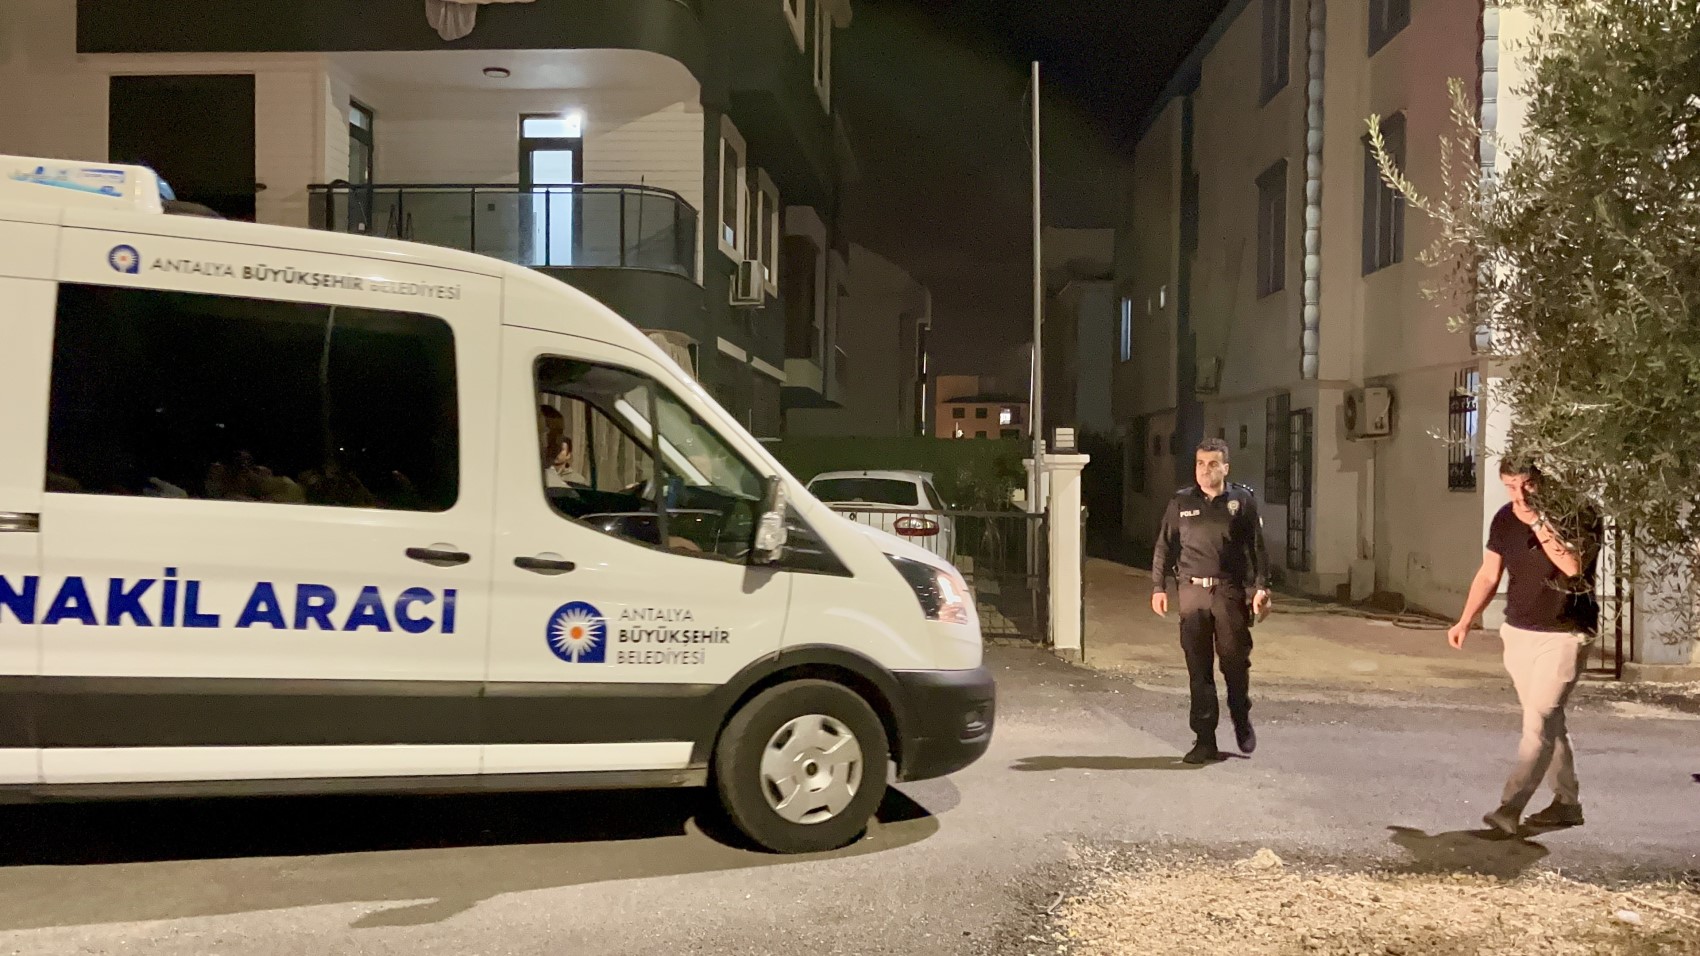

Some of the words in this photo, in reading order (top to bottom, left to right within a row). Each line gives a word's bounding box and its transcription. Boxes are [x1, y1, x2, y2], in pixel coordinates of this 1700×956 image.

[152, 257, 236, 278] ANTALYA
[242, 263, 364, 291] BÜYÜKŞEHİR
[368, 280, 461, 300] BELEDİYESİ
[0, 567, 220, 628] NAKİL
[235, 581, 458, 634] ARACI
[618, 607, 695, 622] ANTALYA
[618, 625, 730, 647] BÜYÜKŞEHİR
[617, 648, 705, 665] BELEDİYESİ
